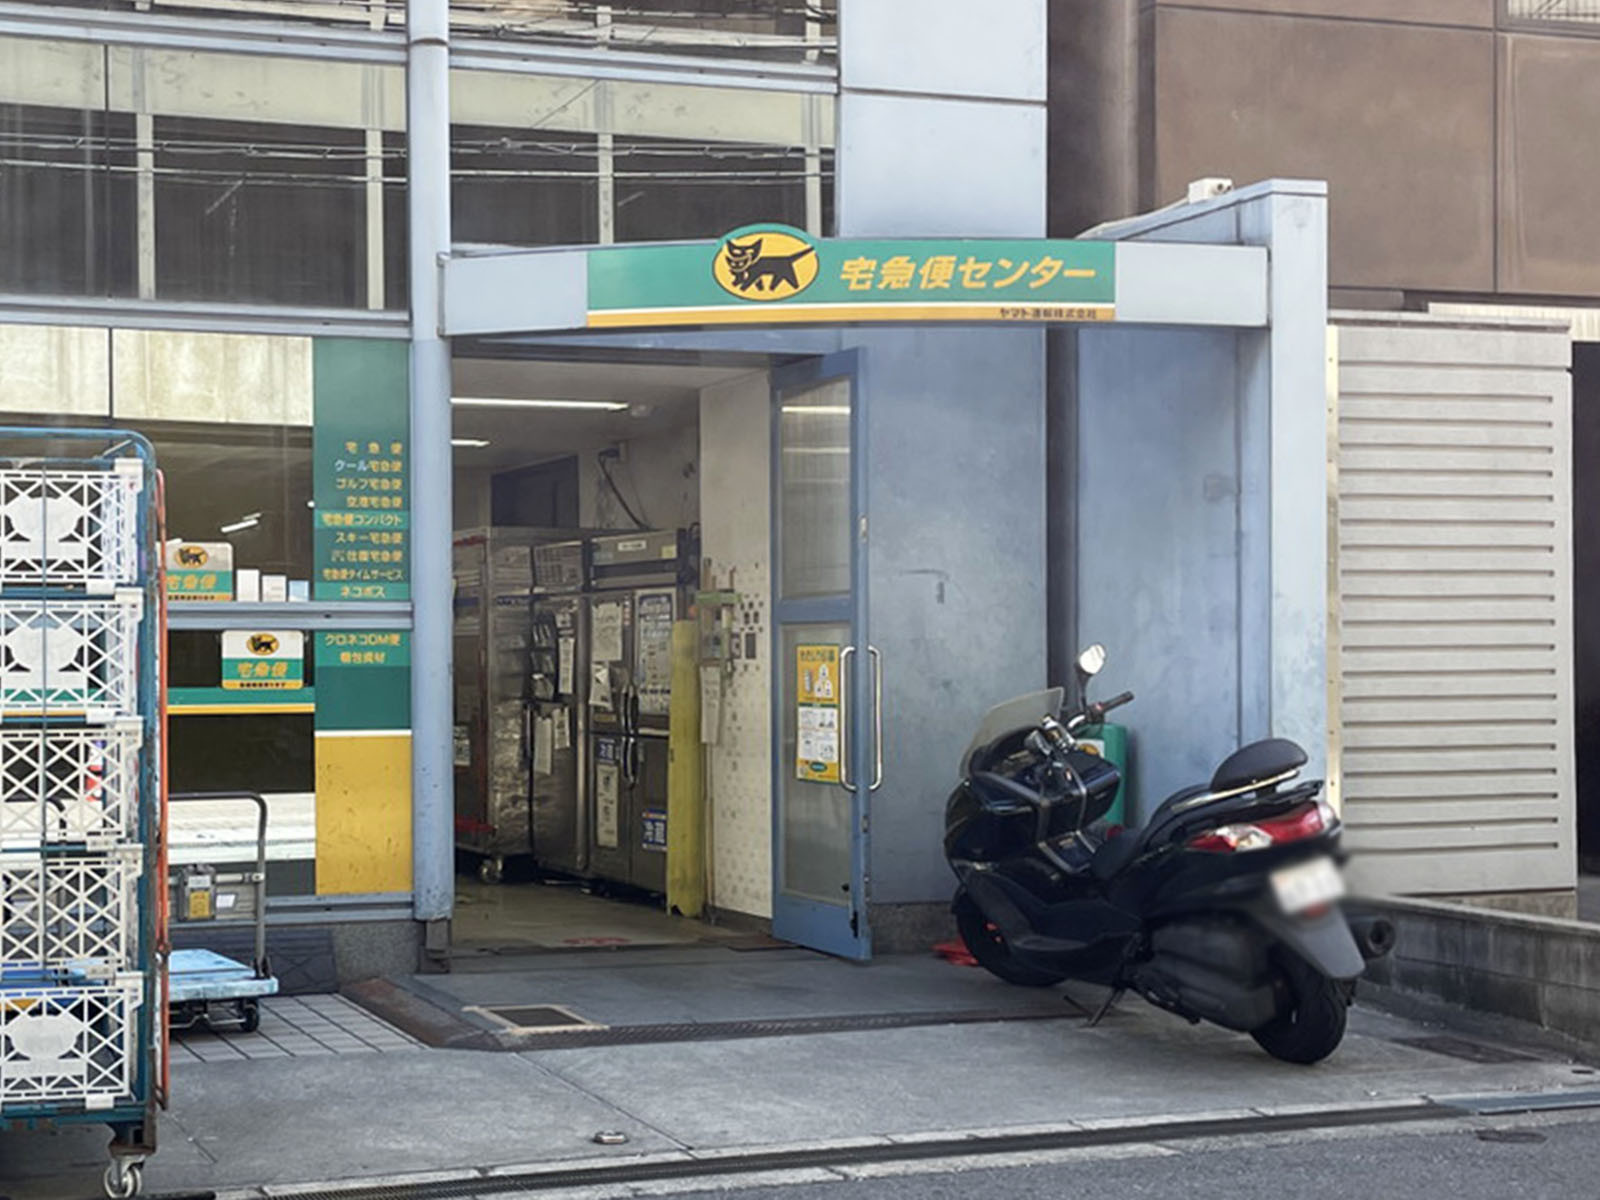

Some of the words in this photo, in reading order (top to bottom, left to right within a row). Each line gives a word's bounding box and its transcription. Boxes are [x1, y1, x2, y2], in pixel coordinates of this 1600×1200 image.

[840, 255, 1096, 291] 宅急便センター
[322, 513, 403, 526] 宅急便コンパクト
[341, 585, 386, 599] ネコポス
